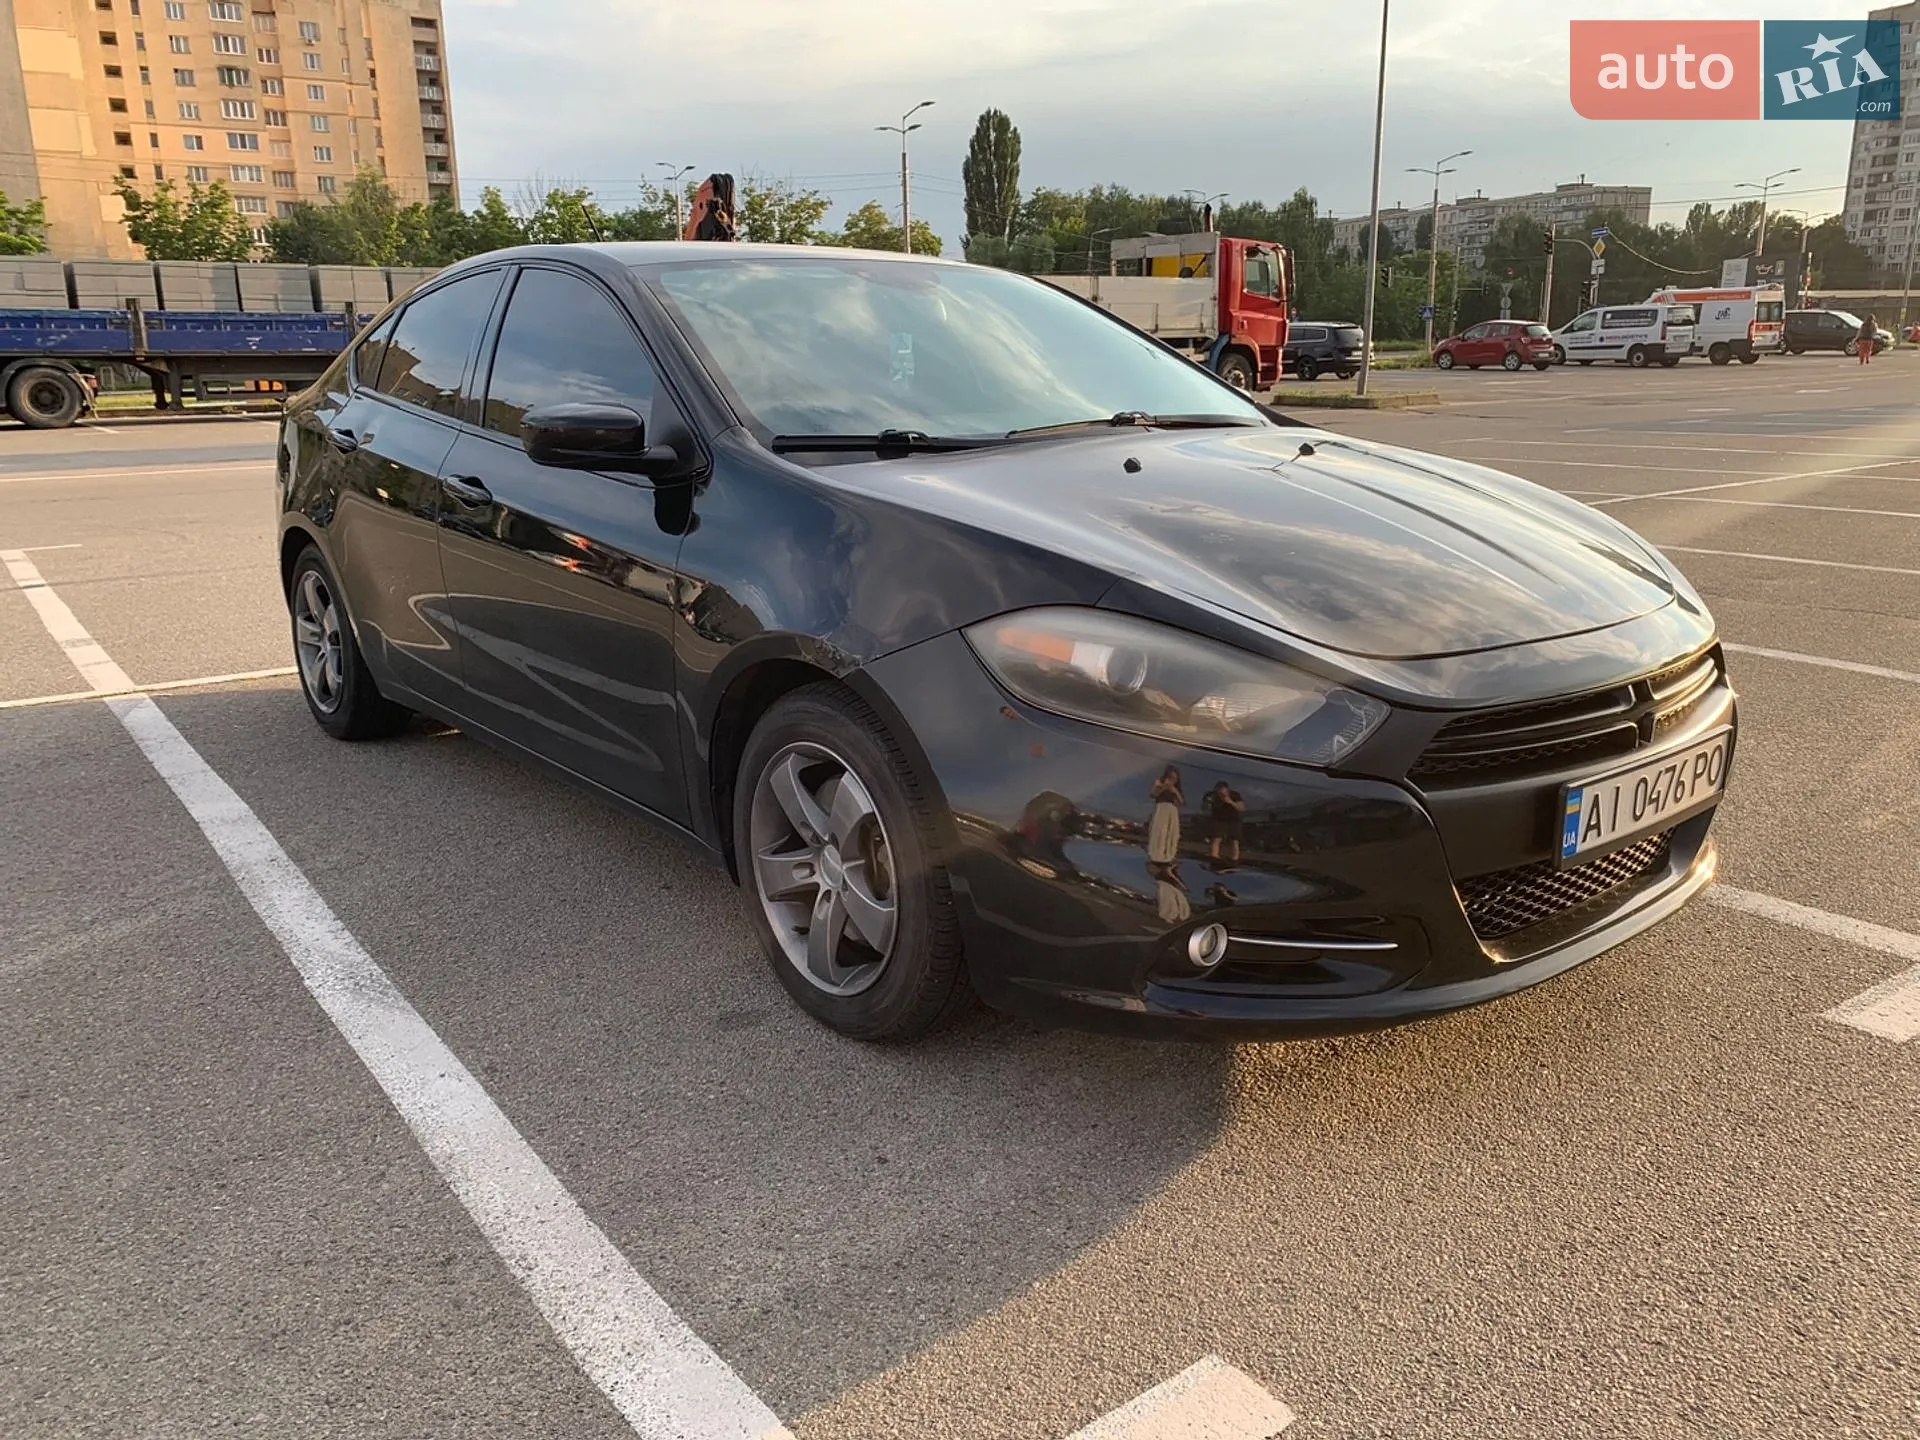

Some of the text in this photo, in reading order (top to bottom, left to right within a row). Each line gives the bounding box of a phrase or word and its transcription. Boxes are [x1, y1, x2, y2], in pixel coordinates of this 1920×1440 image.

[1581, 744, 1724, 843] AI 0476 PO
[1563, 833, 1576, 848] UA
